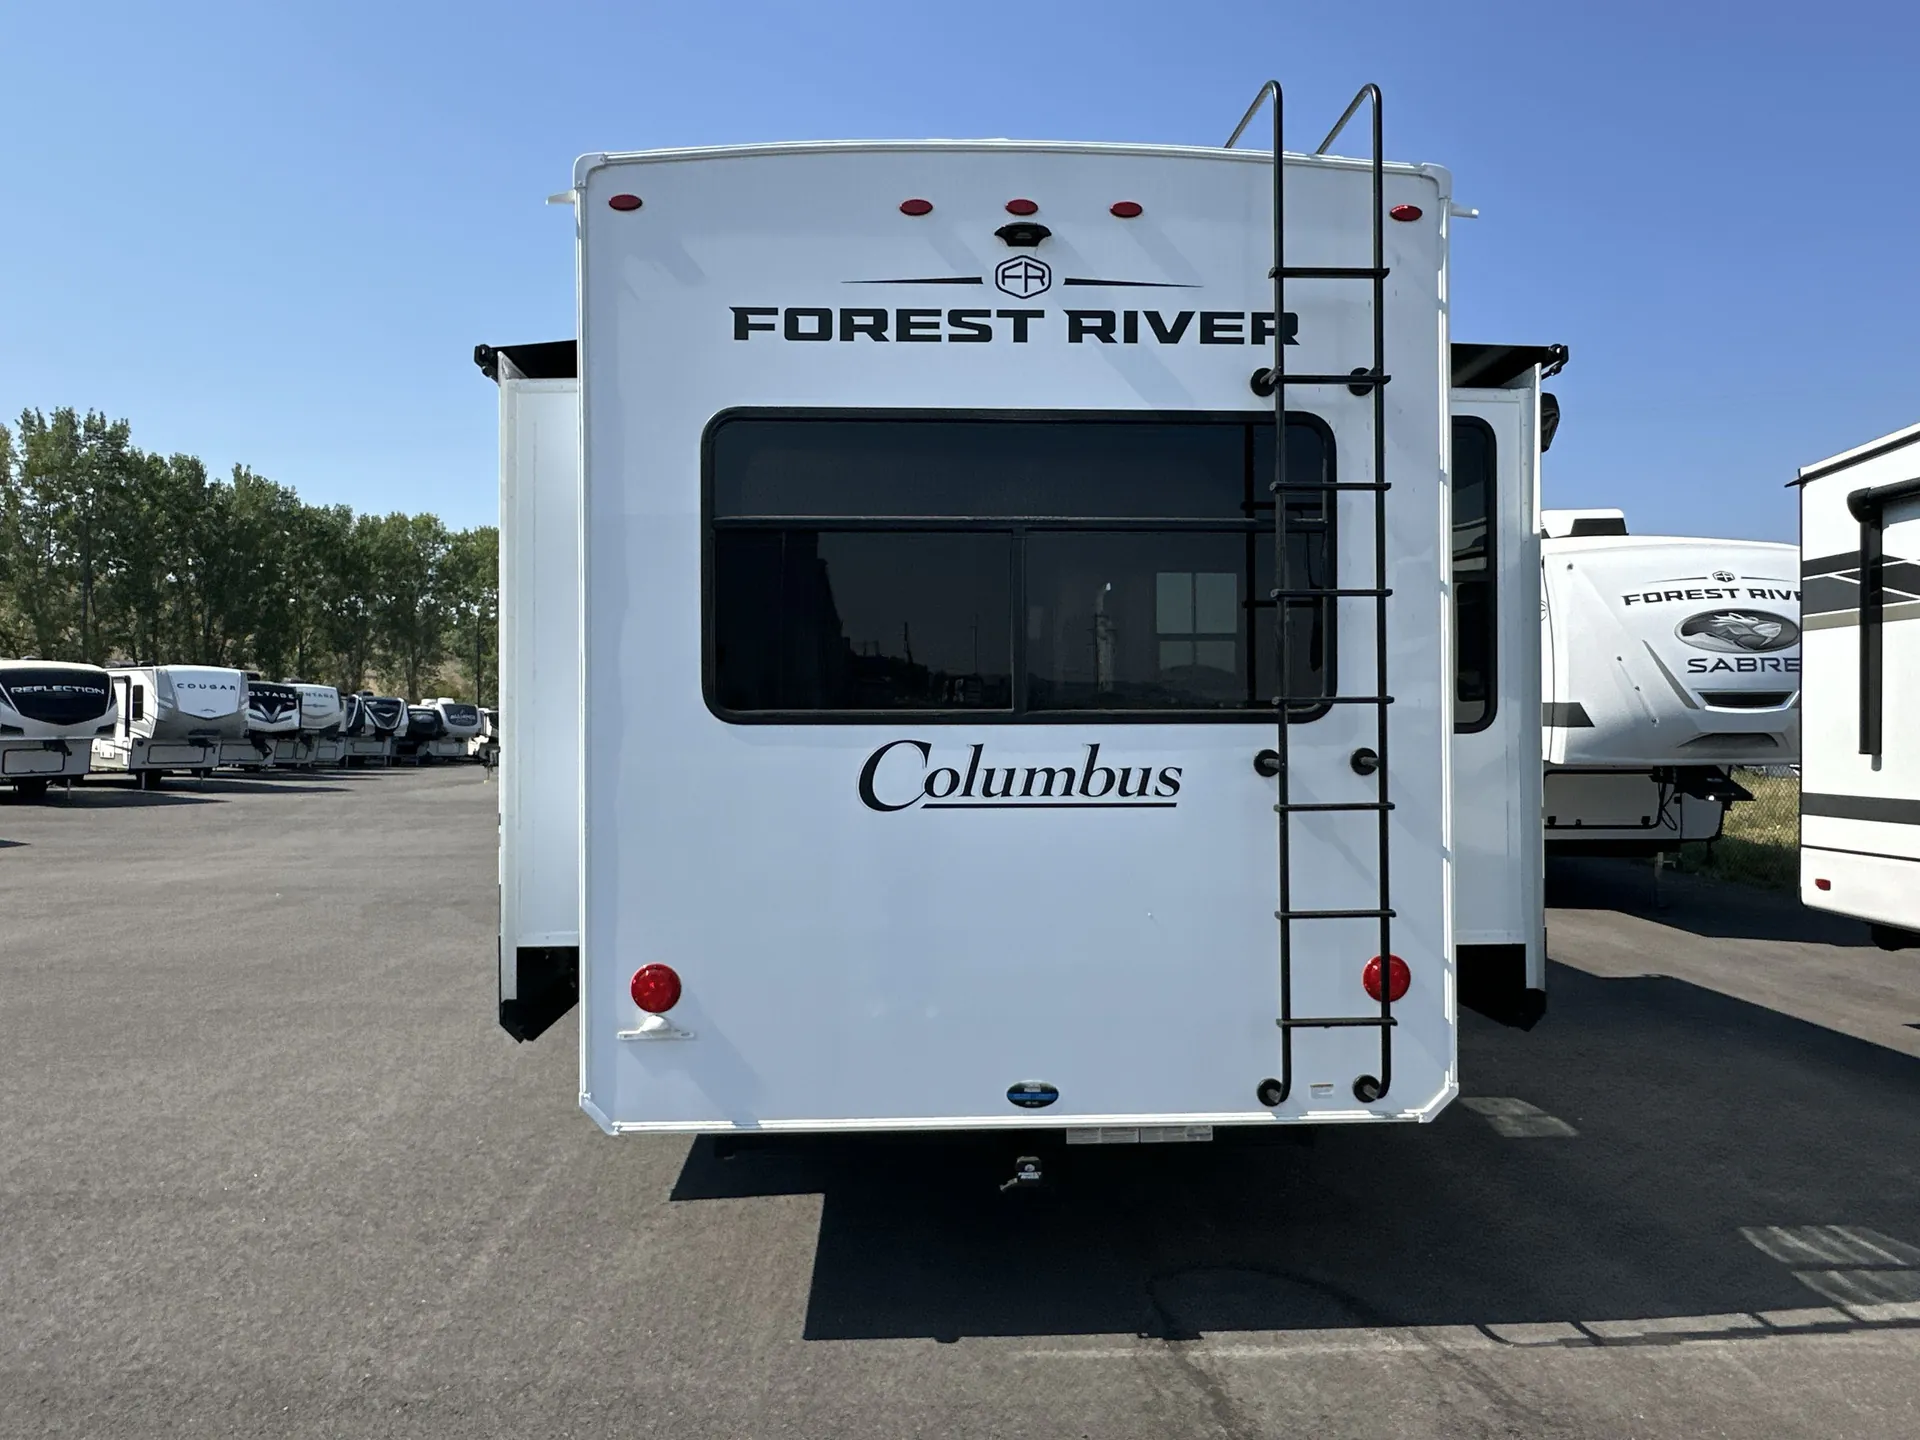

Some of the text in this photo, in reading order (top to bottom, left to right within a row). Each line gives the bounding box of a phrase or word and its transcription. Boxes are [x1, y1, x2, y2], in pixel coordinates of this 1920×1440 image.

[729, 306, 1300, 346] FOREST RIVER
[1621, 588, 1740, 605] FOREST
[1687, 657, 1801, 674] SABRE
[10, 685, 105, 695] REFLECTION
[176, 682, 237, 691] COUGAR
[857, 739, 1184, 812] Columbus
